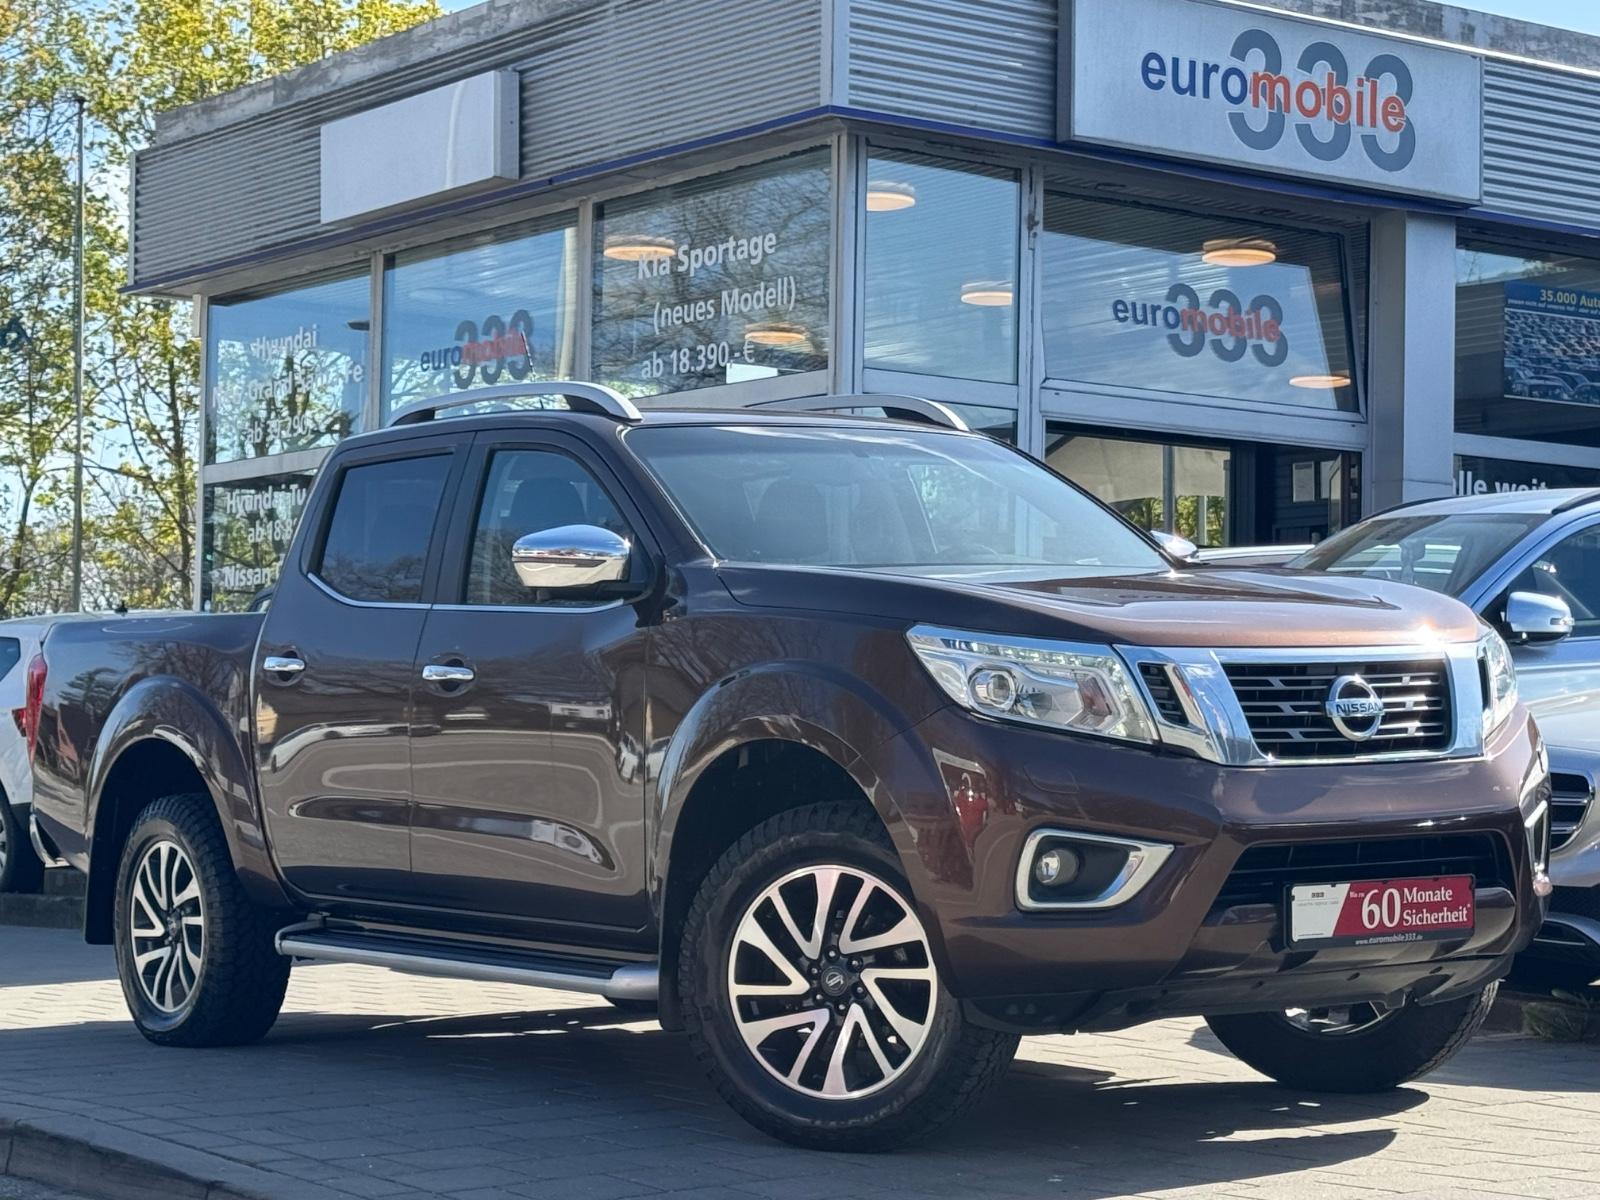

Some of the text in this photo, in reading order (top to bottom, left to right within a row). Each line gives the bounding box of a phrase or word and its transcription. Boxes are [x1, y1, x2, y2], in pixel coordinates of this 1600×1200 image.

[1141, 51, 1406, 133] euromobile
[1227, 28, 1416, 172] 333
[637, 232, 776, 279] Kia Sportage
[653, 275, 796, 335] (neues Modell)
[1540, 289, 1577, 304] 35.000
[1112, 298, 1281, 342] euromobile
[255, 323, 318, 362] Hyundai
[641, 351, 663, 379] ab
[248, 520, 264, 544] ab
[223, 564, 271, 589] Nissan
[1335, 702, 1381, 714] NISSAN
[1362, 886, 1453, 929] 60 Monate
